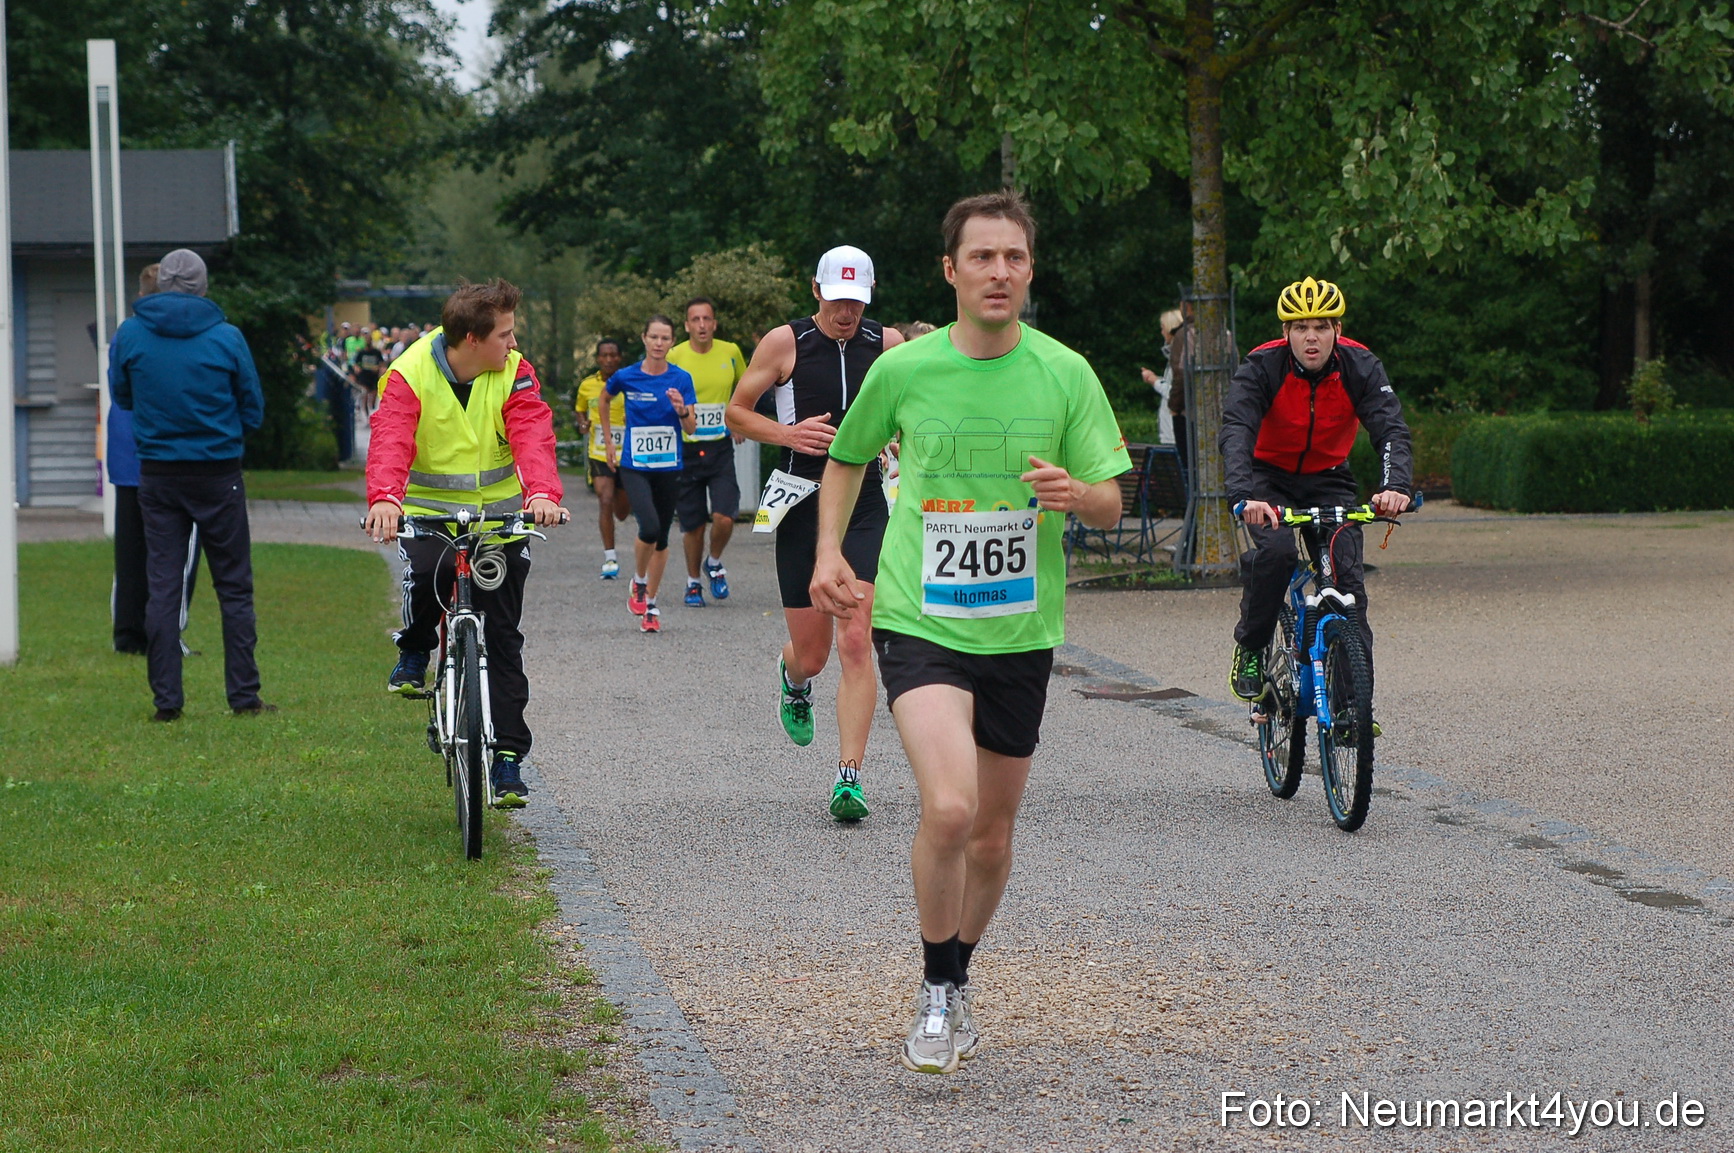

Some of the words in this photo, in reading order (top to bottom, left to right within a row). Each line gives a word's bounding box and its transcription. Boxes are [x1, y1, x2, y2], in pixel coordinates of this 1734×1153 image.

[636, 435, 672, 453] 2047
[775, 477, 806, 493] Neumarkt
[922, 498, 976, 513] MERZ
[926, 523, 961, 534] PARTL
[964, 522, 1019, 534] Neumarkt
[935, 536, 1027, 579] 2465
[954, 588, 1008, 604] thomas
